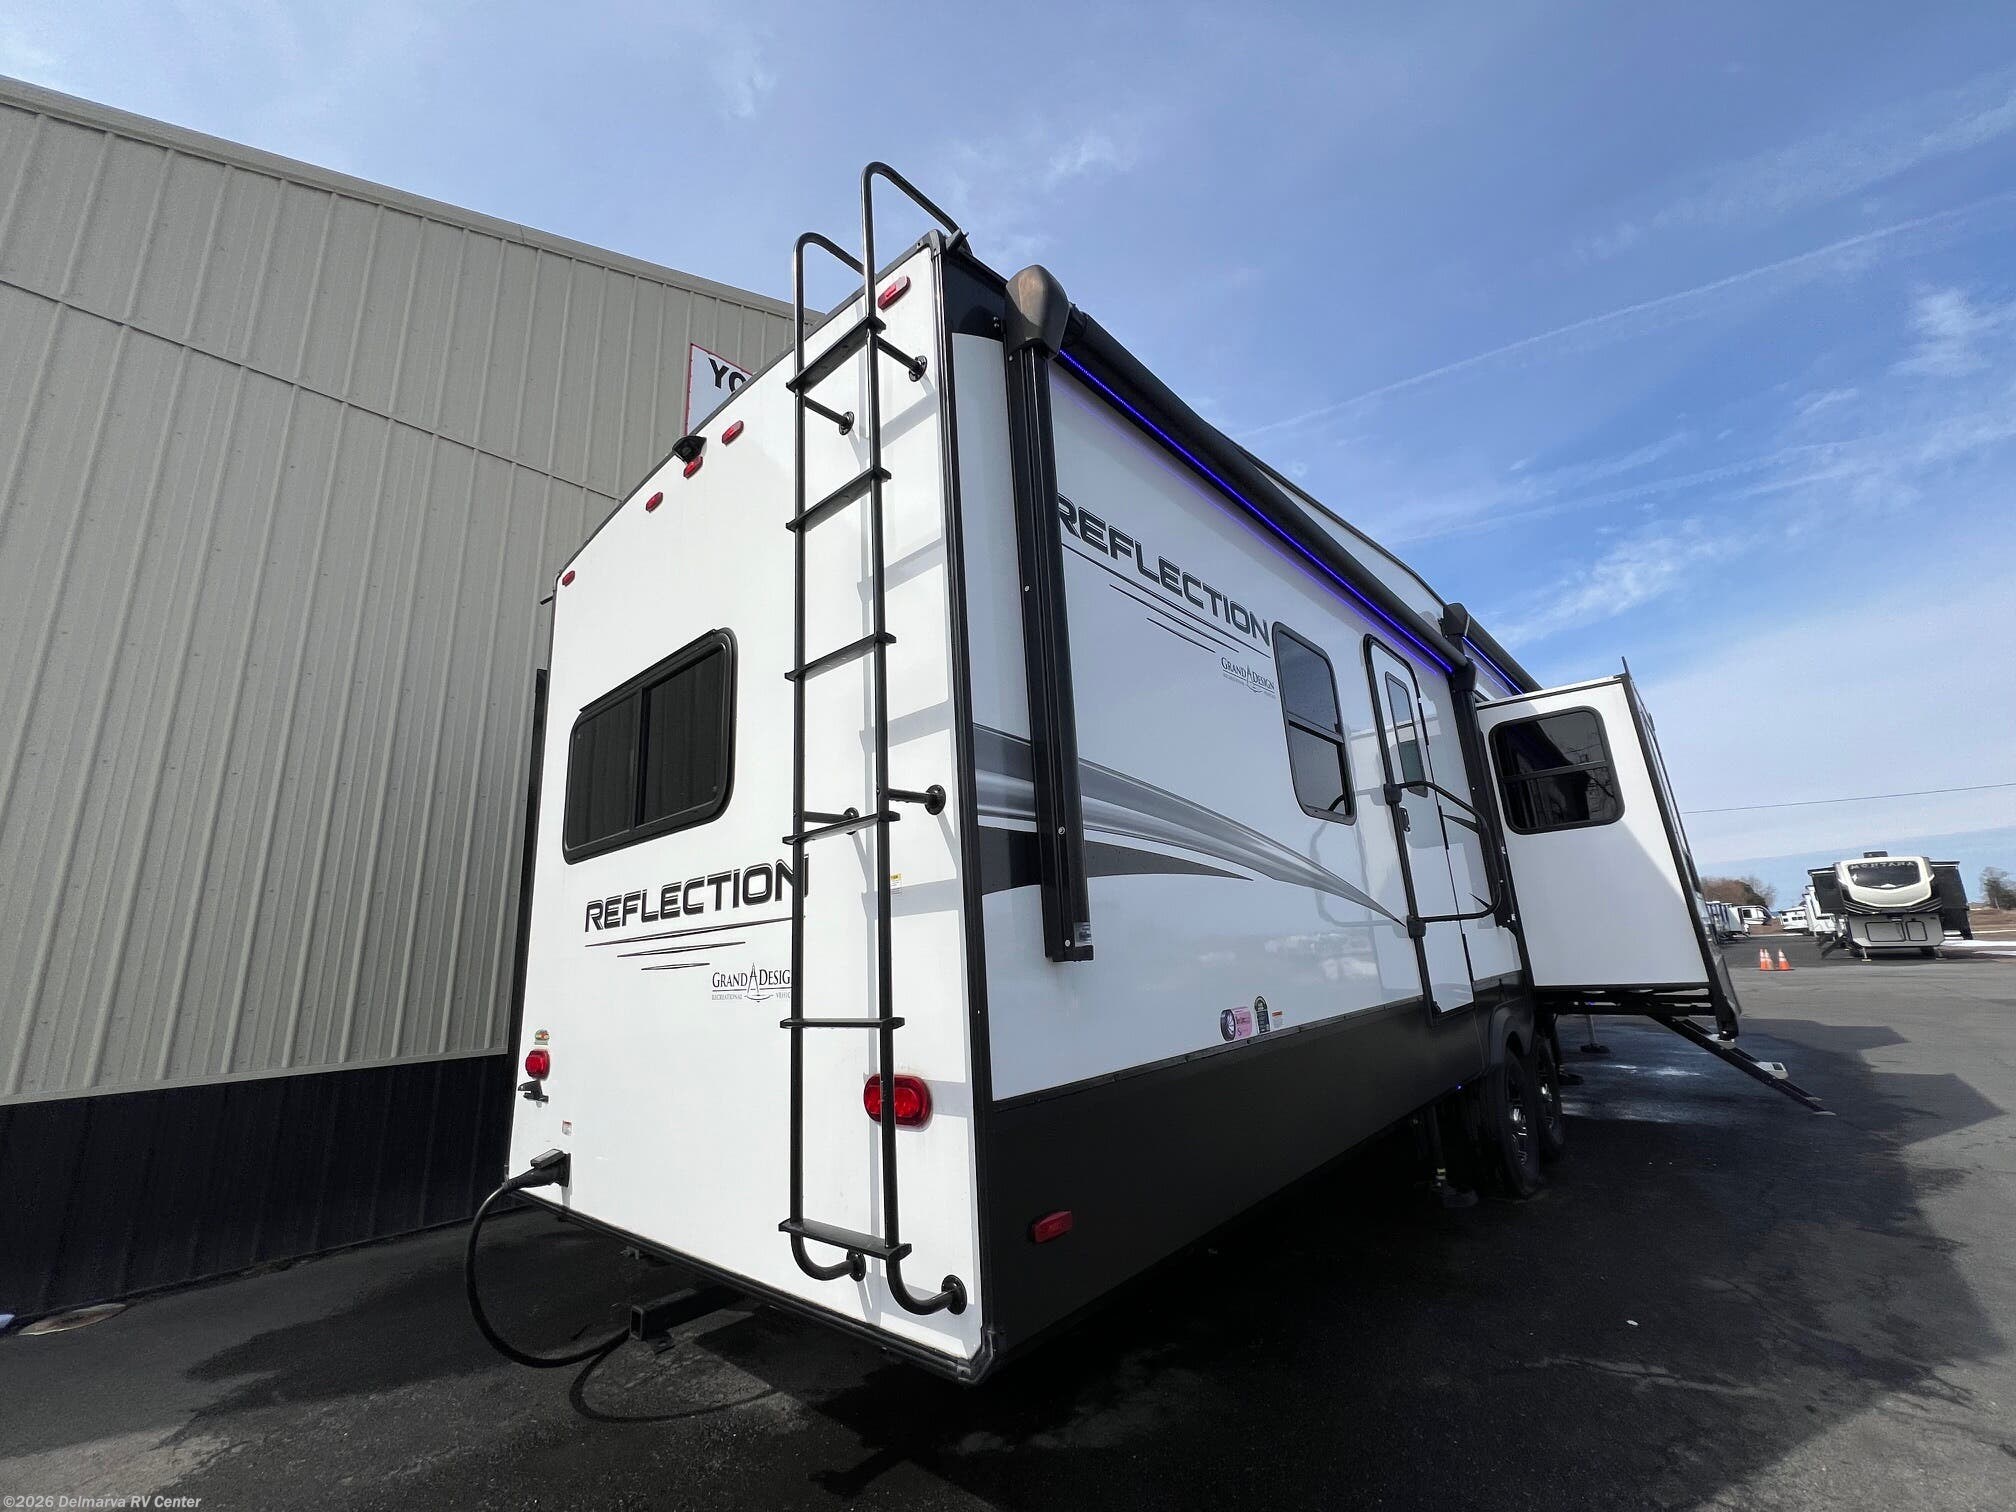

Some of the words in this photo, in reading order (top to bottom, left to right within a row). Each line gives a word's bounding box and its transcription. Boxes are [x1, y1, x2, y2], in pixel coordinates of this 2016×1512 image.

[1057, 492, 1271, 648] REFLECTION
[1850, 861, 1915, 870] MONTANA
[584, 853, 809, 933] REFLECTION
[712, 971, 748, 988] GRAND
[759, 968, 791, 986] DESIG
